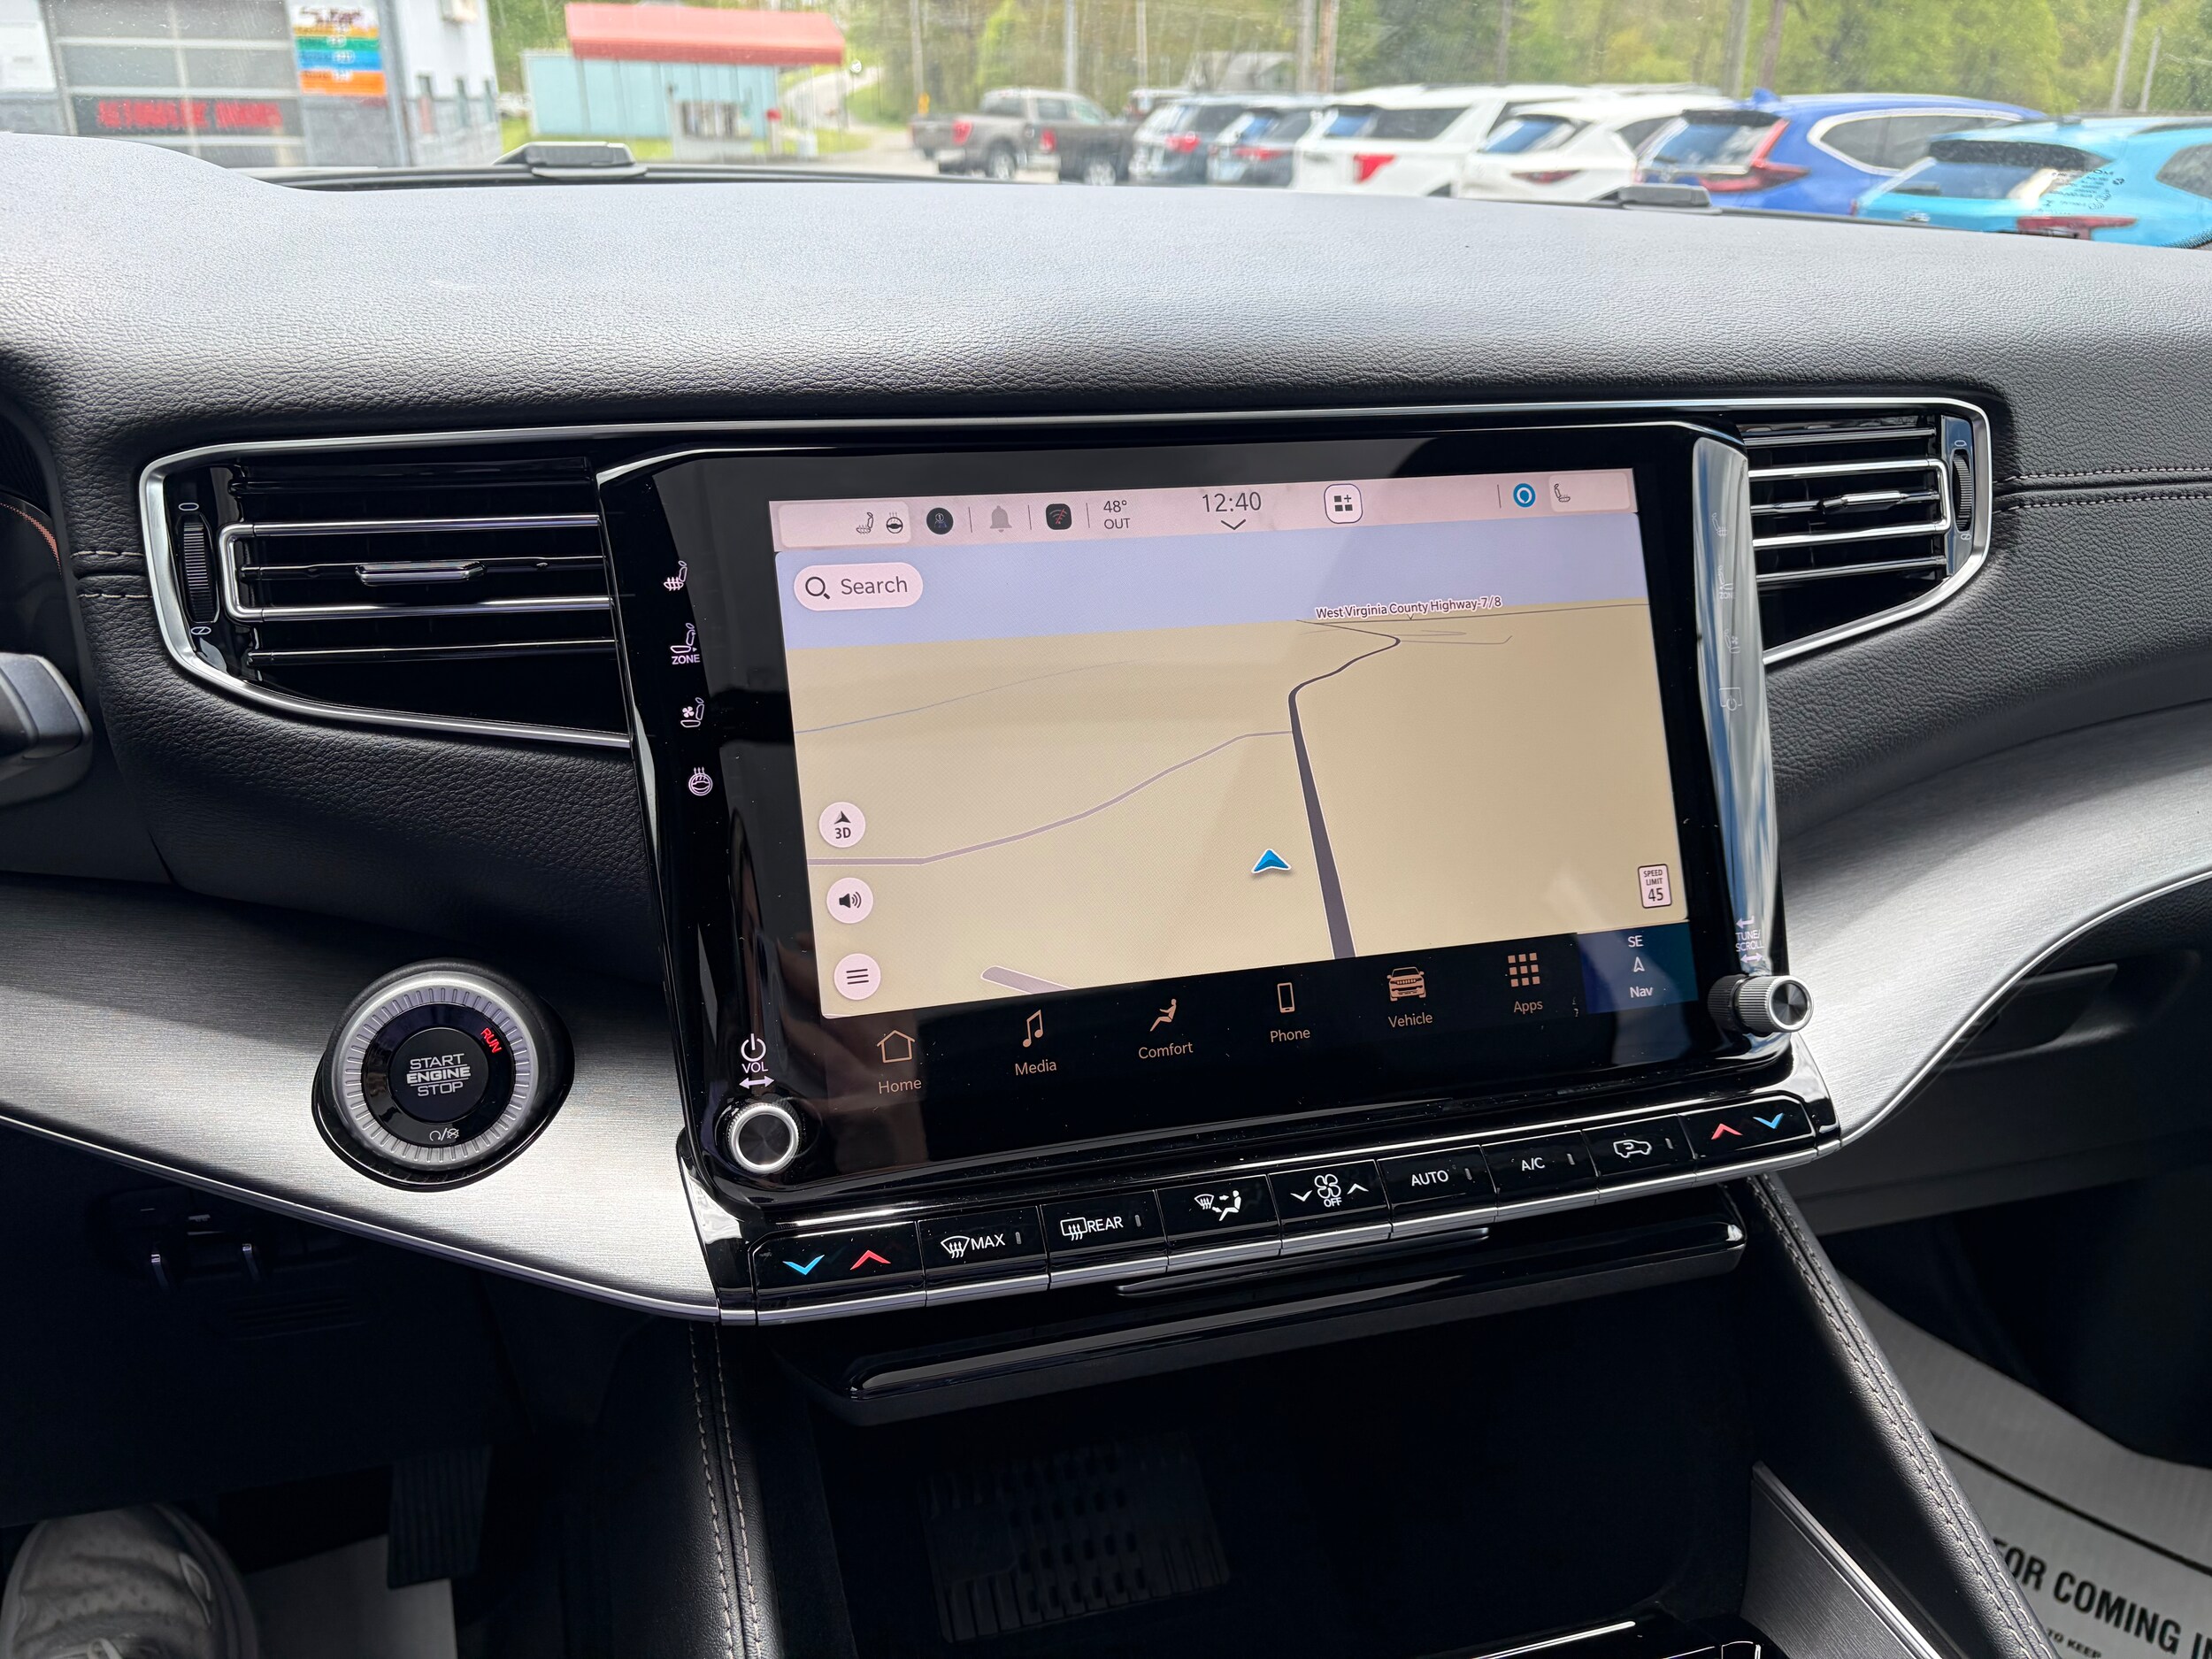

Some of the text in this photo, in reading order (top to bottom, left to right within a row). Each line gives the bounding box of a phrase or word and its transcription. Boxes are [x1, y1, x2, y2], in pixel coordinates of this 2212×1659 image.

[1103, 499, 1128, 514] 48°
[1202, 491, 1262, 512] 12:40
[1103, 518, 1131, 530] OUT
[840, 574, 909, 596] Search
[1316, 607, 1343, 619] West
[1343, 603, 1388, 618] Virginia
[1389, 601, 1429, 616] County
[671, 654, 701, 665] ZONE
[834, 826, 851, 839] 3D
[1643, 869, 1663, 878] SPEED
[1646, 877, 1663, 886] LIMIT
[1647, 887, 1664, 902] 45
[1628, 935, 1644, 948] SE
[1735, 941, 1765, 952] SCROLL
[1630, 985, 1654, 998] Nav
[1513, 998, 1544, 1016] Apps
[1387, 1011, 1433, 1029] Vehicle
[480, 1027, 502, 1053] RUN
[1269, 1026, 1311, 1044] Phone
[1138, 1040, 1194, 1060] Comfort
[410, 1053, 465, 1070] START
[741, 1061, 769, 1074] VOL
[1014, 1057, 1057, 1076] Media
[406, 1066, 471, 1084] ENGINE
[418, 1081, 464, 1097] STOP
[878, 1076, 922, 1095] Home
[1521, 1157, 1546, 1172] A/C
[1411, 1170, 1449, 1187] AUTO
[1323, 1197, 1342, 1208] OFF
[1088, 1215, 1124, 1232] REAR
[971, 1233, 1005, 1250] MAX
[2054, 1571, 2181, 1655] COMING
